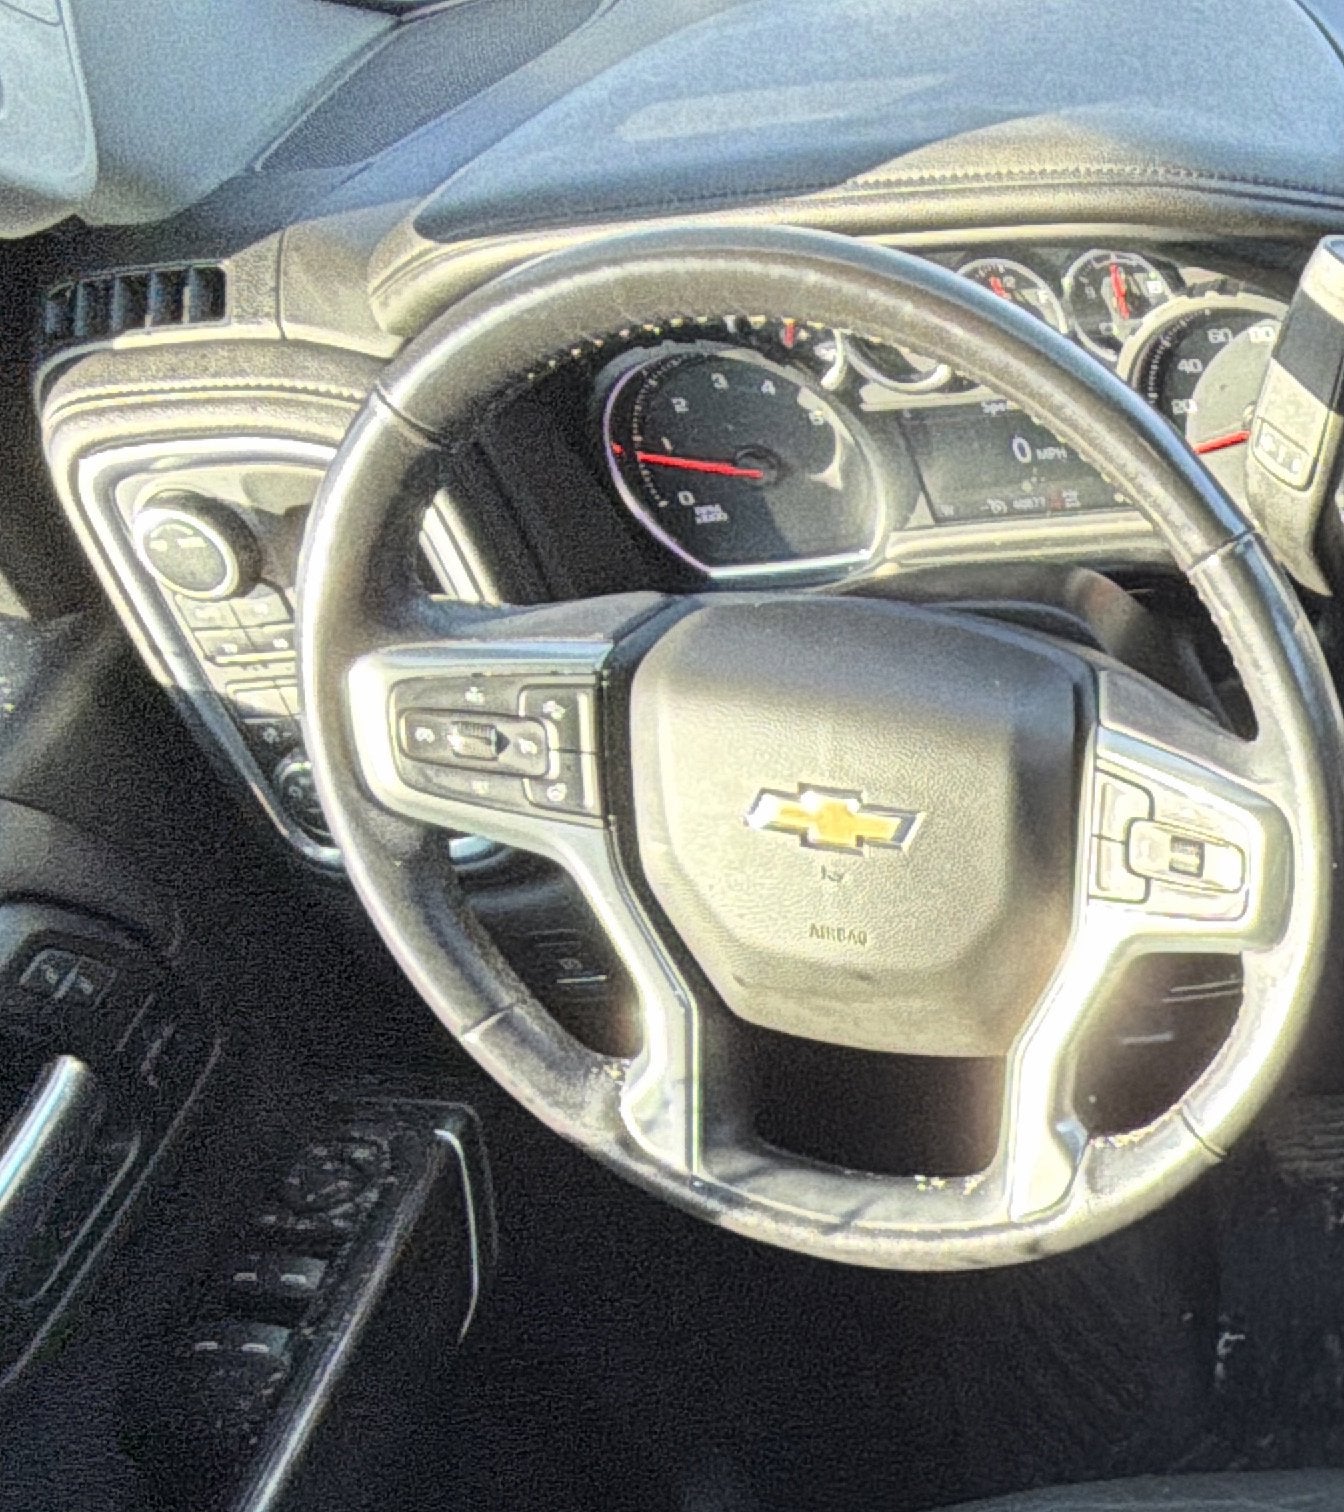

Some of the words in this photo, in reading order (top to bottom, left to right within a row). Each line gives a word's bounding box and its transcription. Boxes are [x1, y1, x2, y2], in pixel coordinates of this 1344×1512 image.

[1206, 327, 1233, 344] 60
[1177, 358, 1203, 374] 40
[671, 397, 690, 413] 2
[1012, 435, 1033, 464] 0
[1036, 446, 1068, 463] MPH
[676, 490, 696, 506] 0
